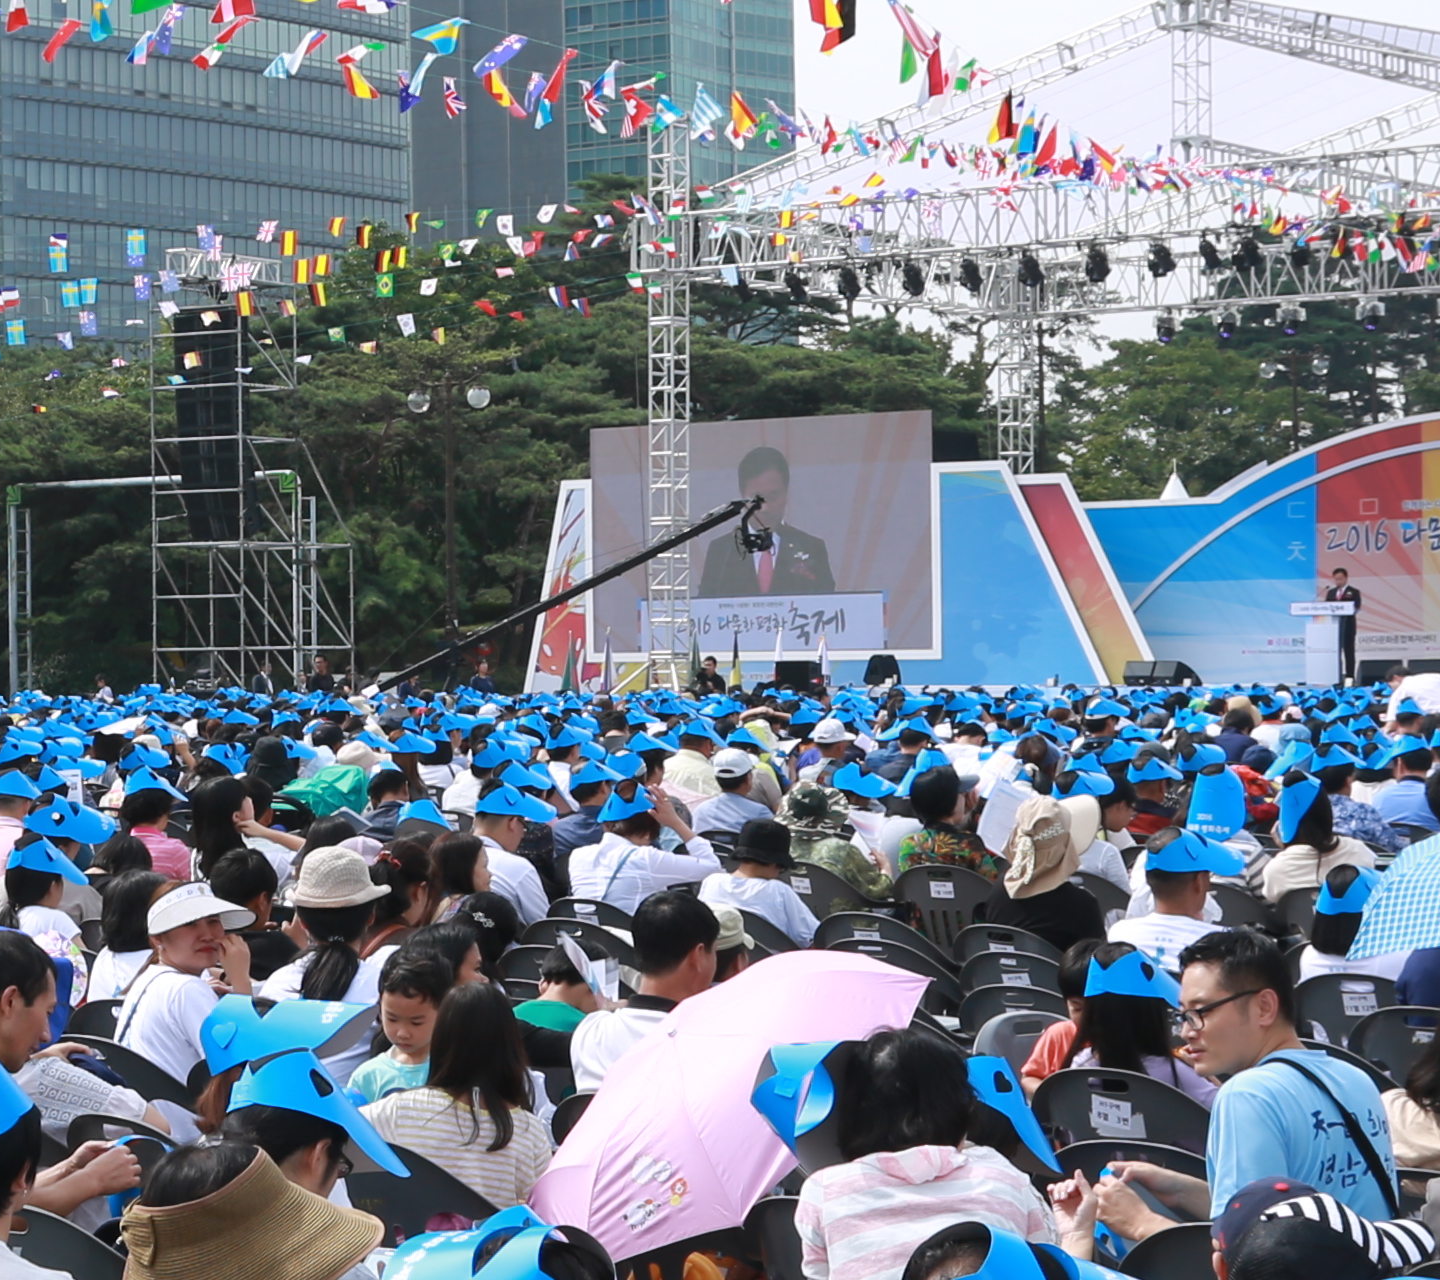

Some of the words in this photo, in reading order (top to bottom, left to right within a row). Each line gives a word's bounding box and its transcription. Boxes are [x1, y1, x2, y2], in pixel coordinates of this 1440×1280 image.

[1326, 519, 1390, 553] 2016
[718, 614, 754, 632] 다문화
[789, 601, 845, 646] 축제
